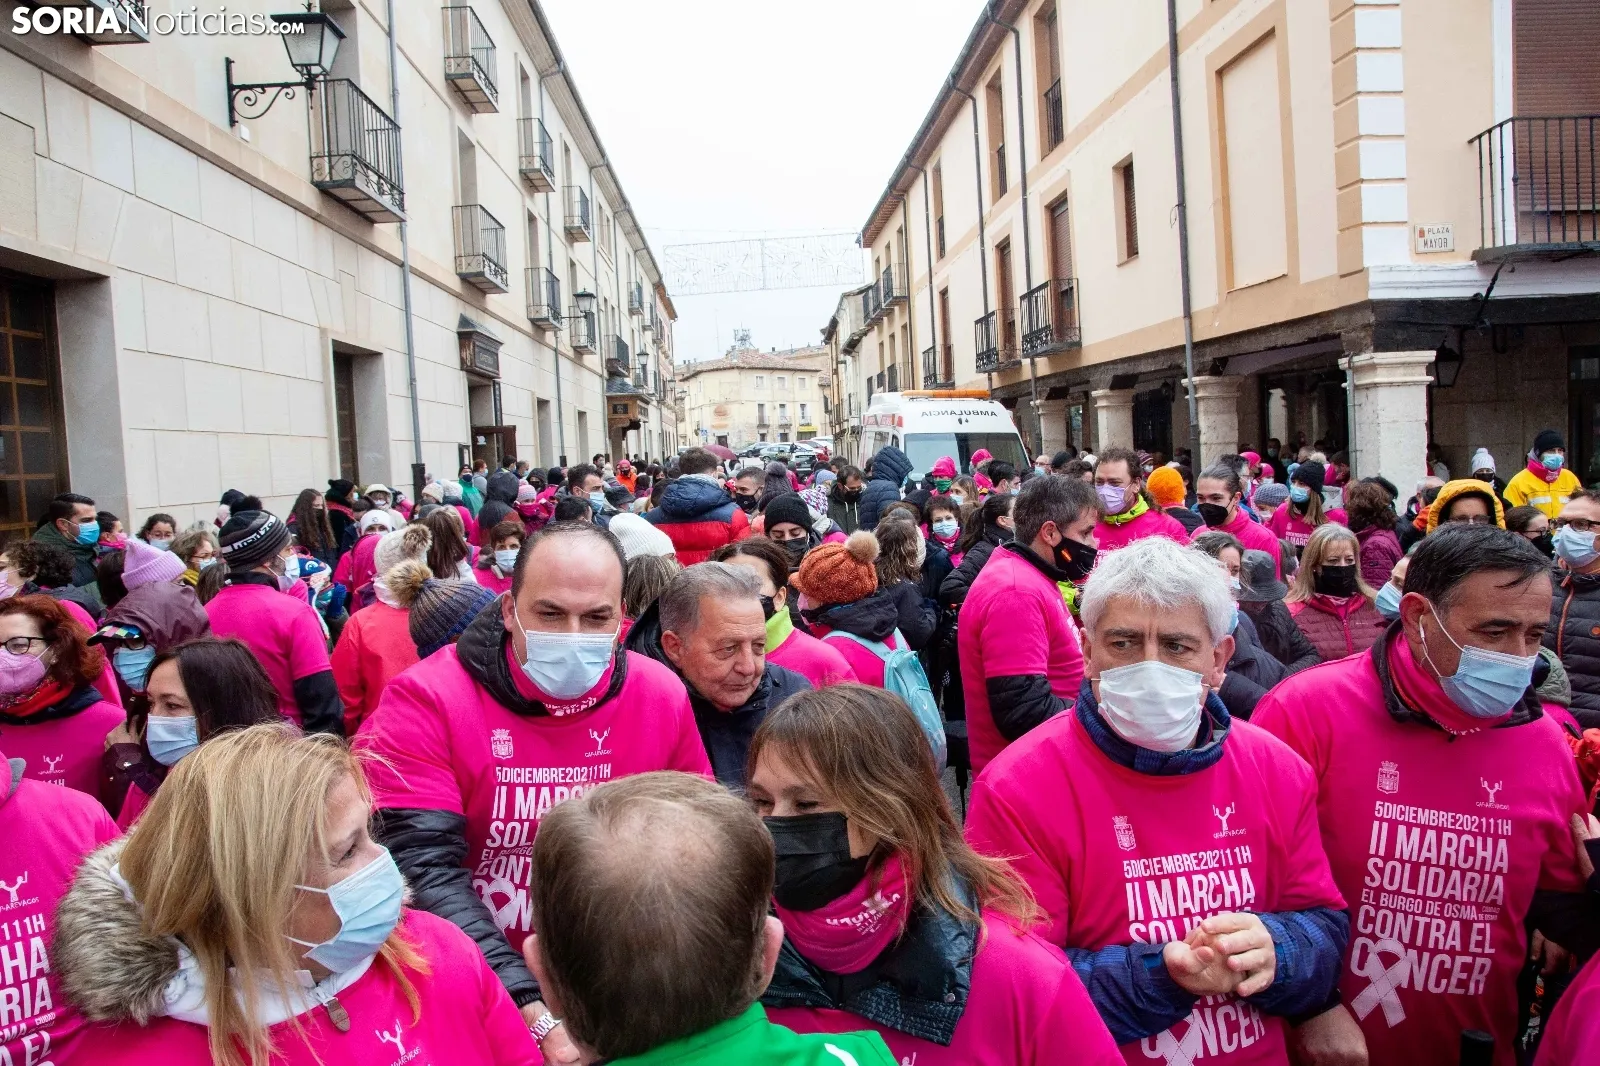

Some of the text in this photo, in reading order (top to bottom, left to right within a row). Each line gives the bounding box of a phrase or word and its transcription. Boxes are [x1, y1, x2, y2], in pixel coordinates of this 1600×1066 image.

[1423, 238, 1448, 249] MAYOR
[1427, 227, 1450, 235] PLAZA
[491, 786, 507, 820] II
[485, 820, 539, 848] SOL
[1368, 820, 1509, 874] II MARCHA
[1125, 867, 1256, 922] II MARCHA
[1364, 857, 1504, 906] SOLIDARIA
[1360, 888, 1478, 921] EL BURGO DE OSMA
[1356, 904, 1496, 954] CONTRA EL
[0, 936, 52, 986] HA
